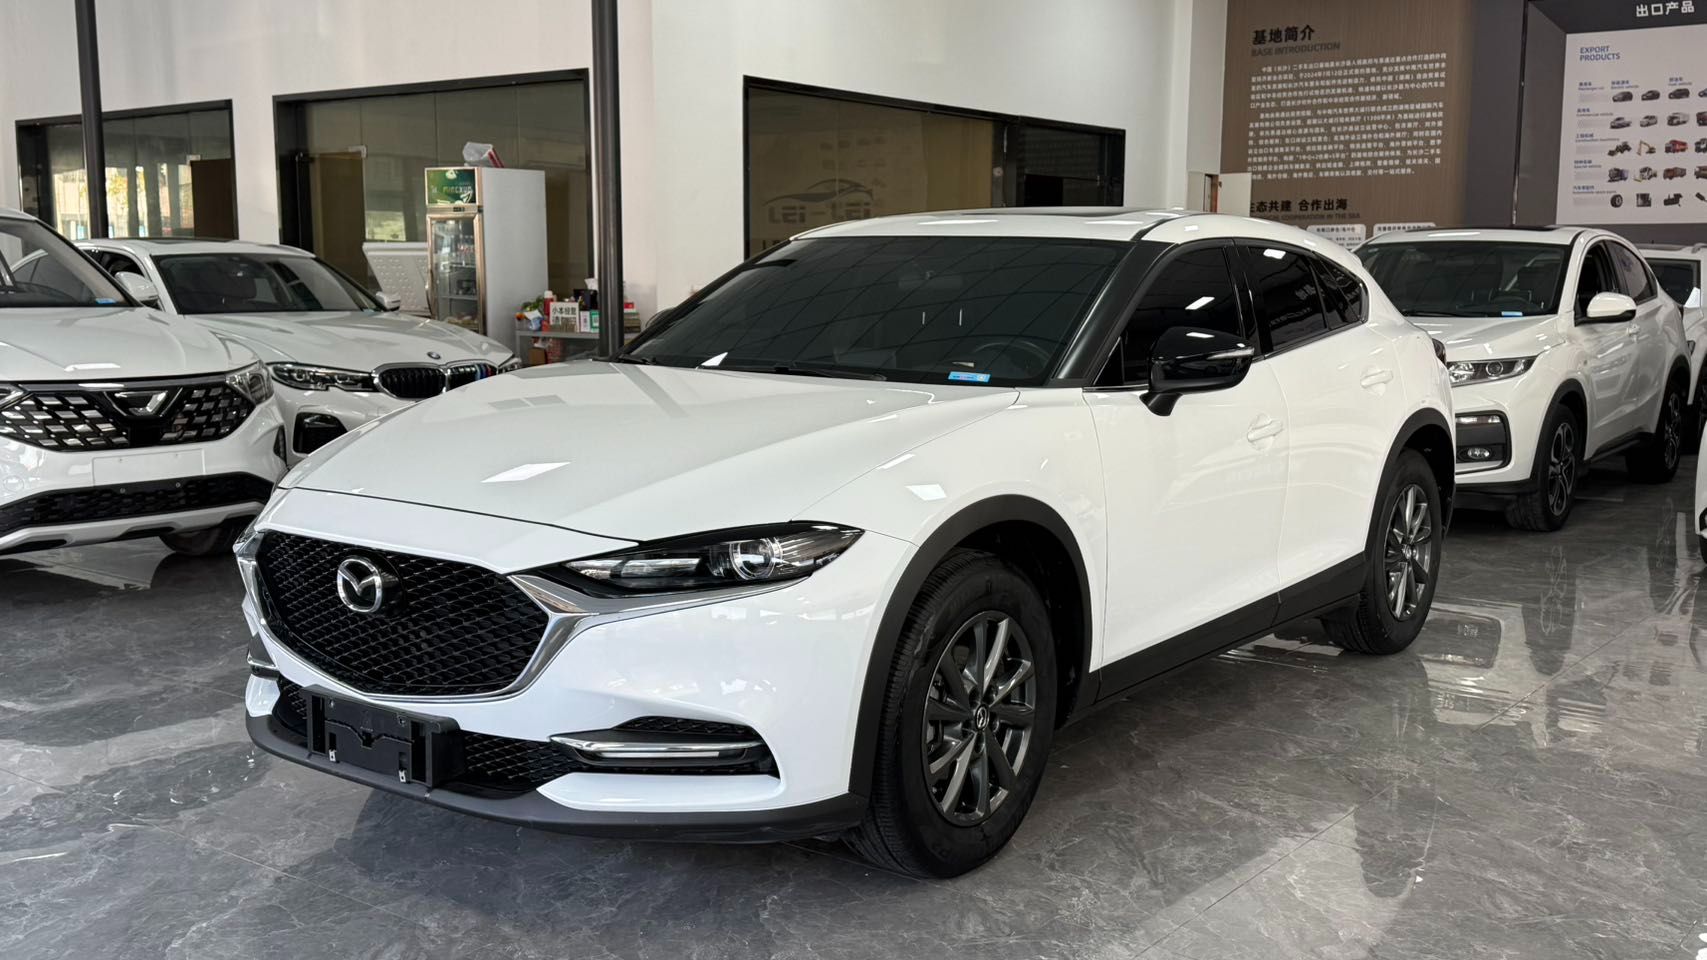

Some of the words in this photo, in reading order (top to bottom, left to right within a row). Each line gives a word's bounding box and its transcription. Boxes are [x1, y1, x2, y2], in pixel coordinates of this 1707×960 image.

[1636, 0, 1695, 17] 出口产品
[1253, 25, 1315, 45] 基地简介
[1251, 46, 1273, 56] BASE
[1274, 42, 1341, 54] INTRODUCTION
[1580, 45, 1610, 54] EXPORT
[1579, 53, 1621, 61] PRODUCTS
[1299, 198, 1347, 211] 合作出海
